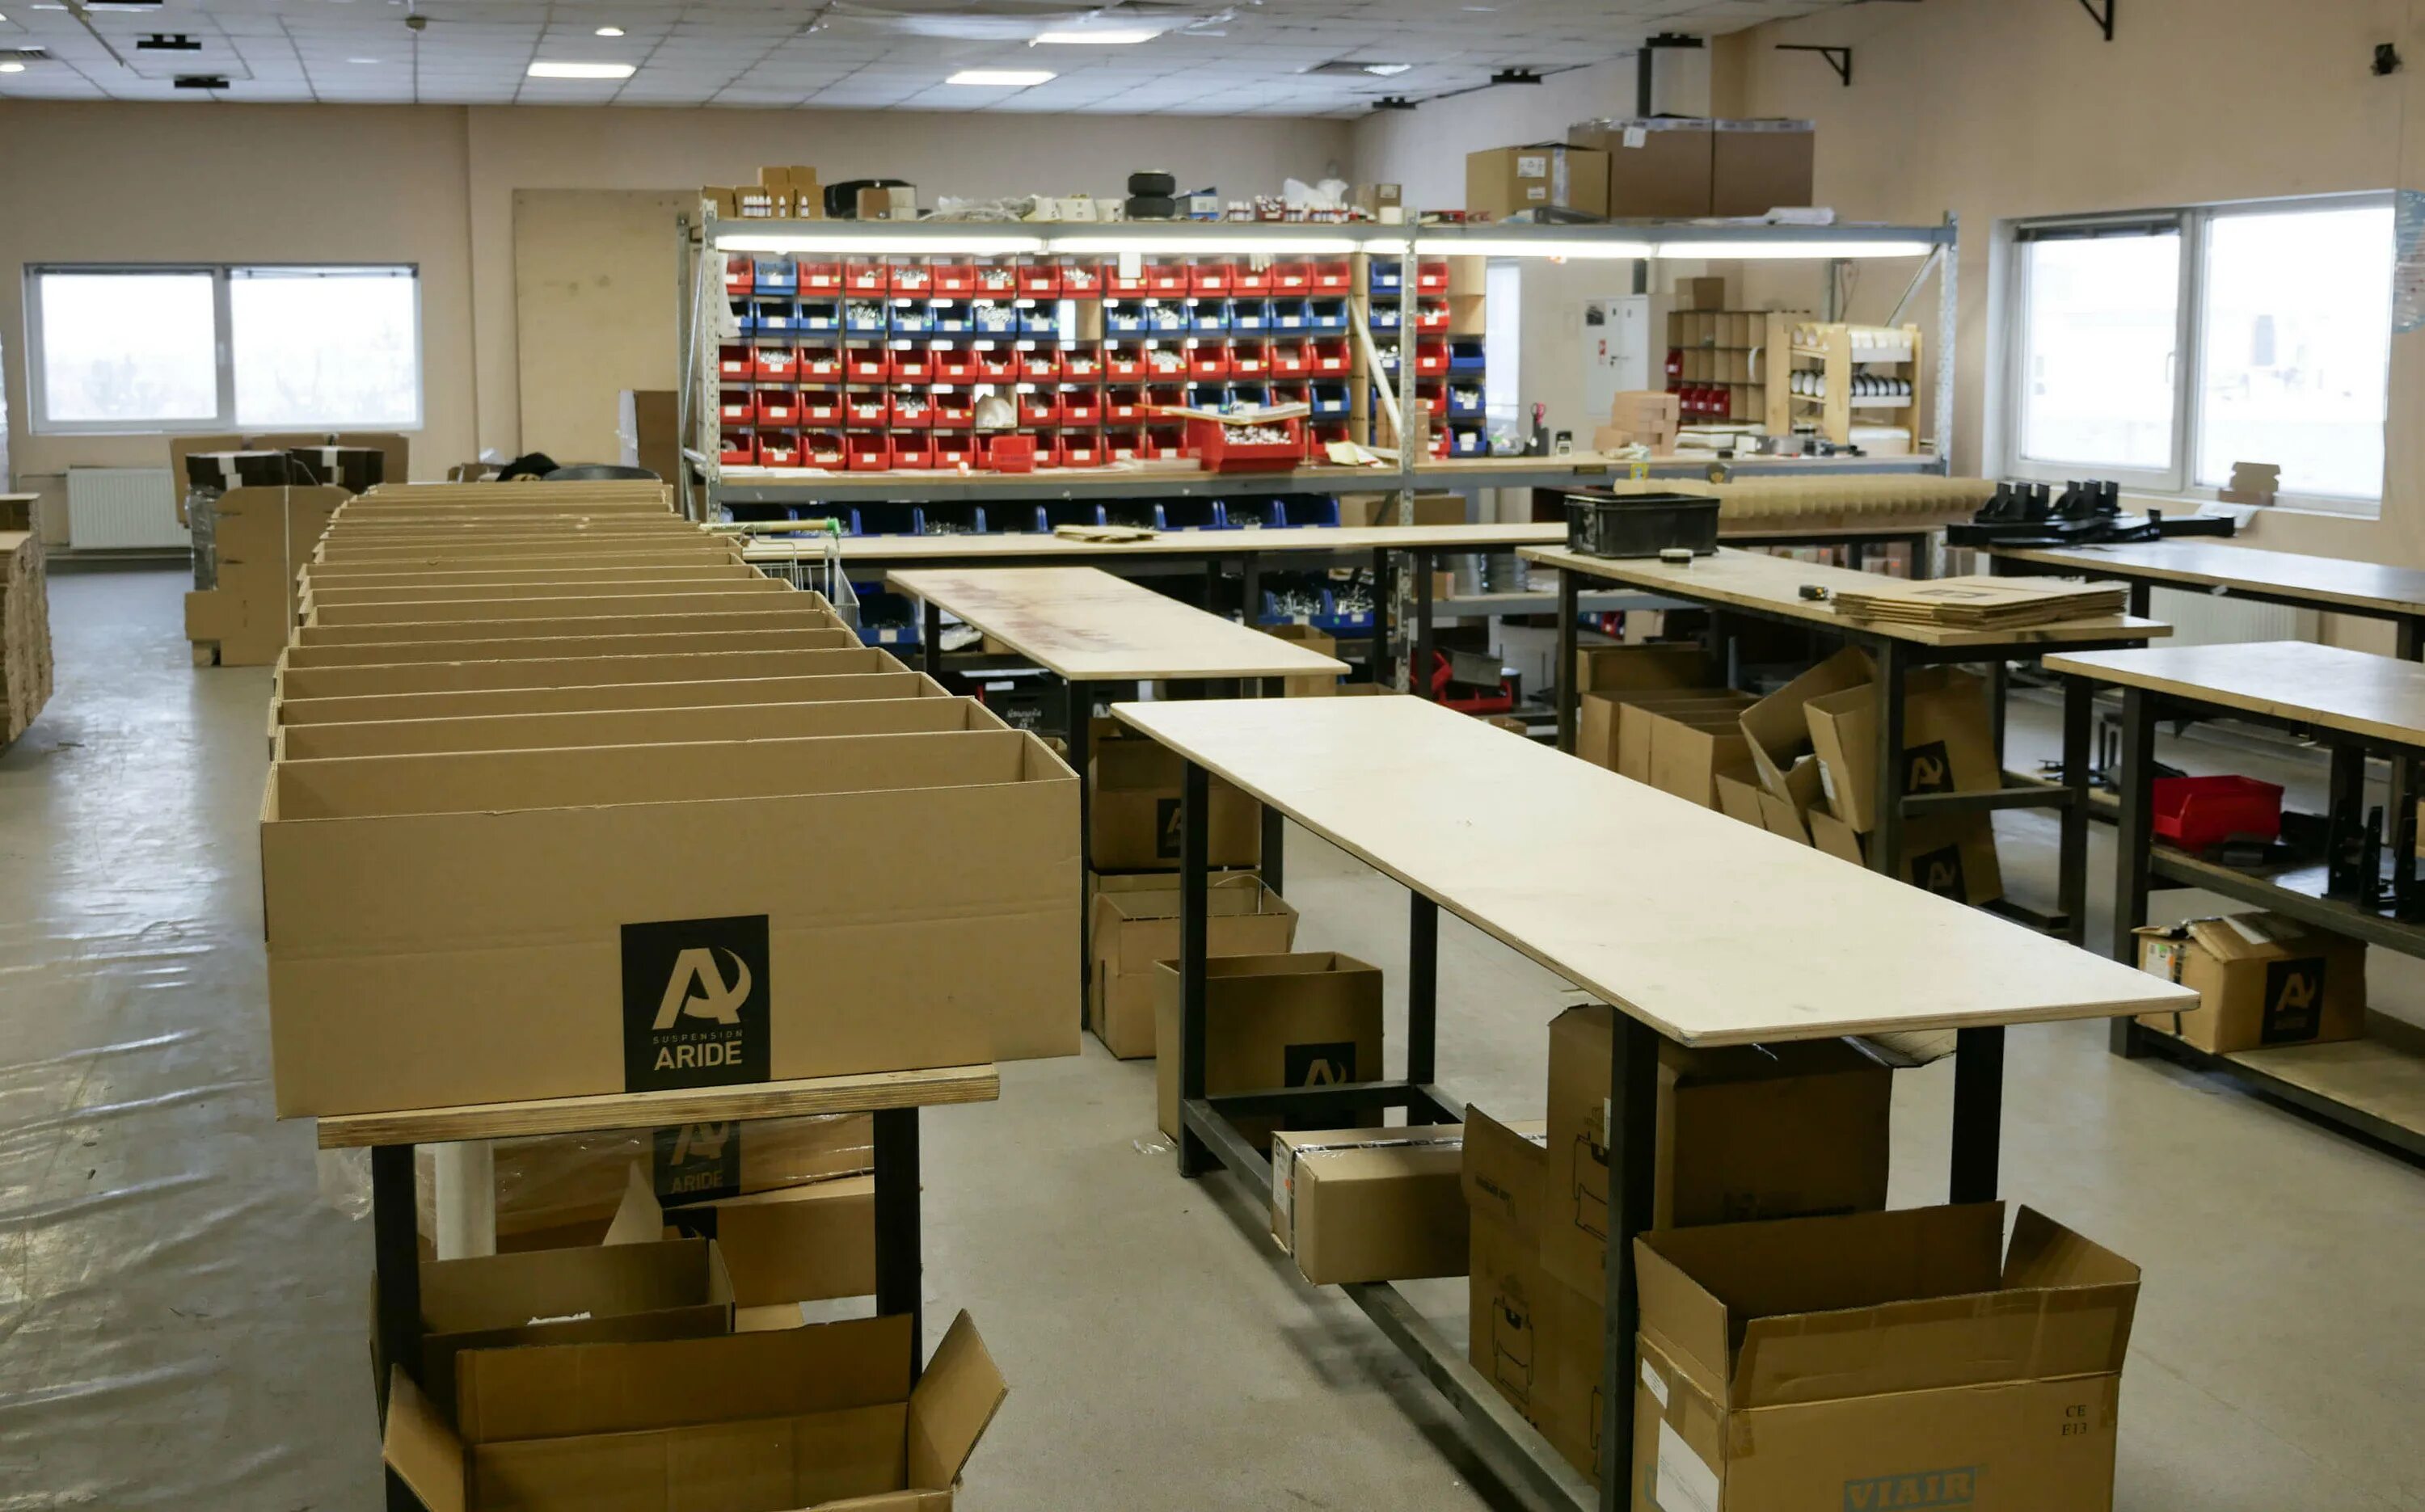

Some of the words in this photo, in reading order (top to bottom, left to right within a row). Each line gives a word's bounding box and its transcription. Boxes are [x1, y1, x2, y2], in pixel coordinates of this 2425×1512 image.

[652, 1029, 743, 1044] SUSPENSION
[653, 1040, 743, 1071] ARIDE
[671, 1170, 723, 1194] ARIDE
[2065, 1405, 2087, 1417] CE
[1848, 1472, 1971, 1510] VIAIR
